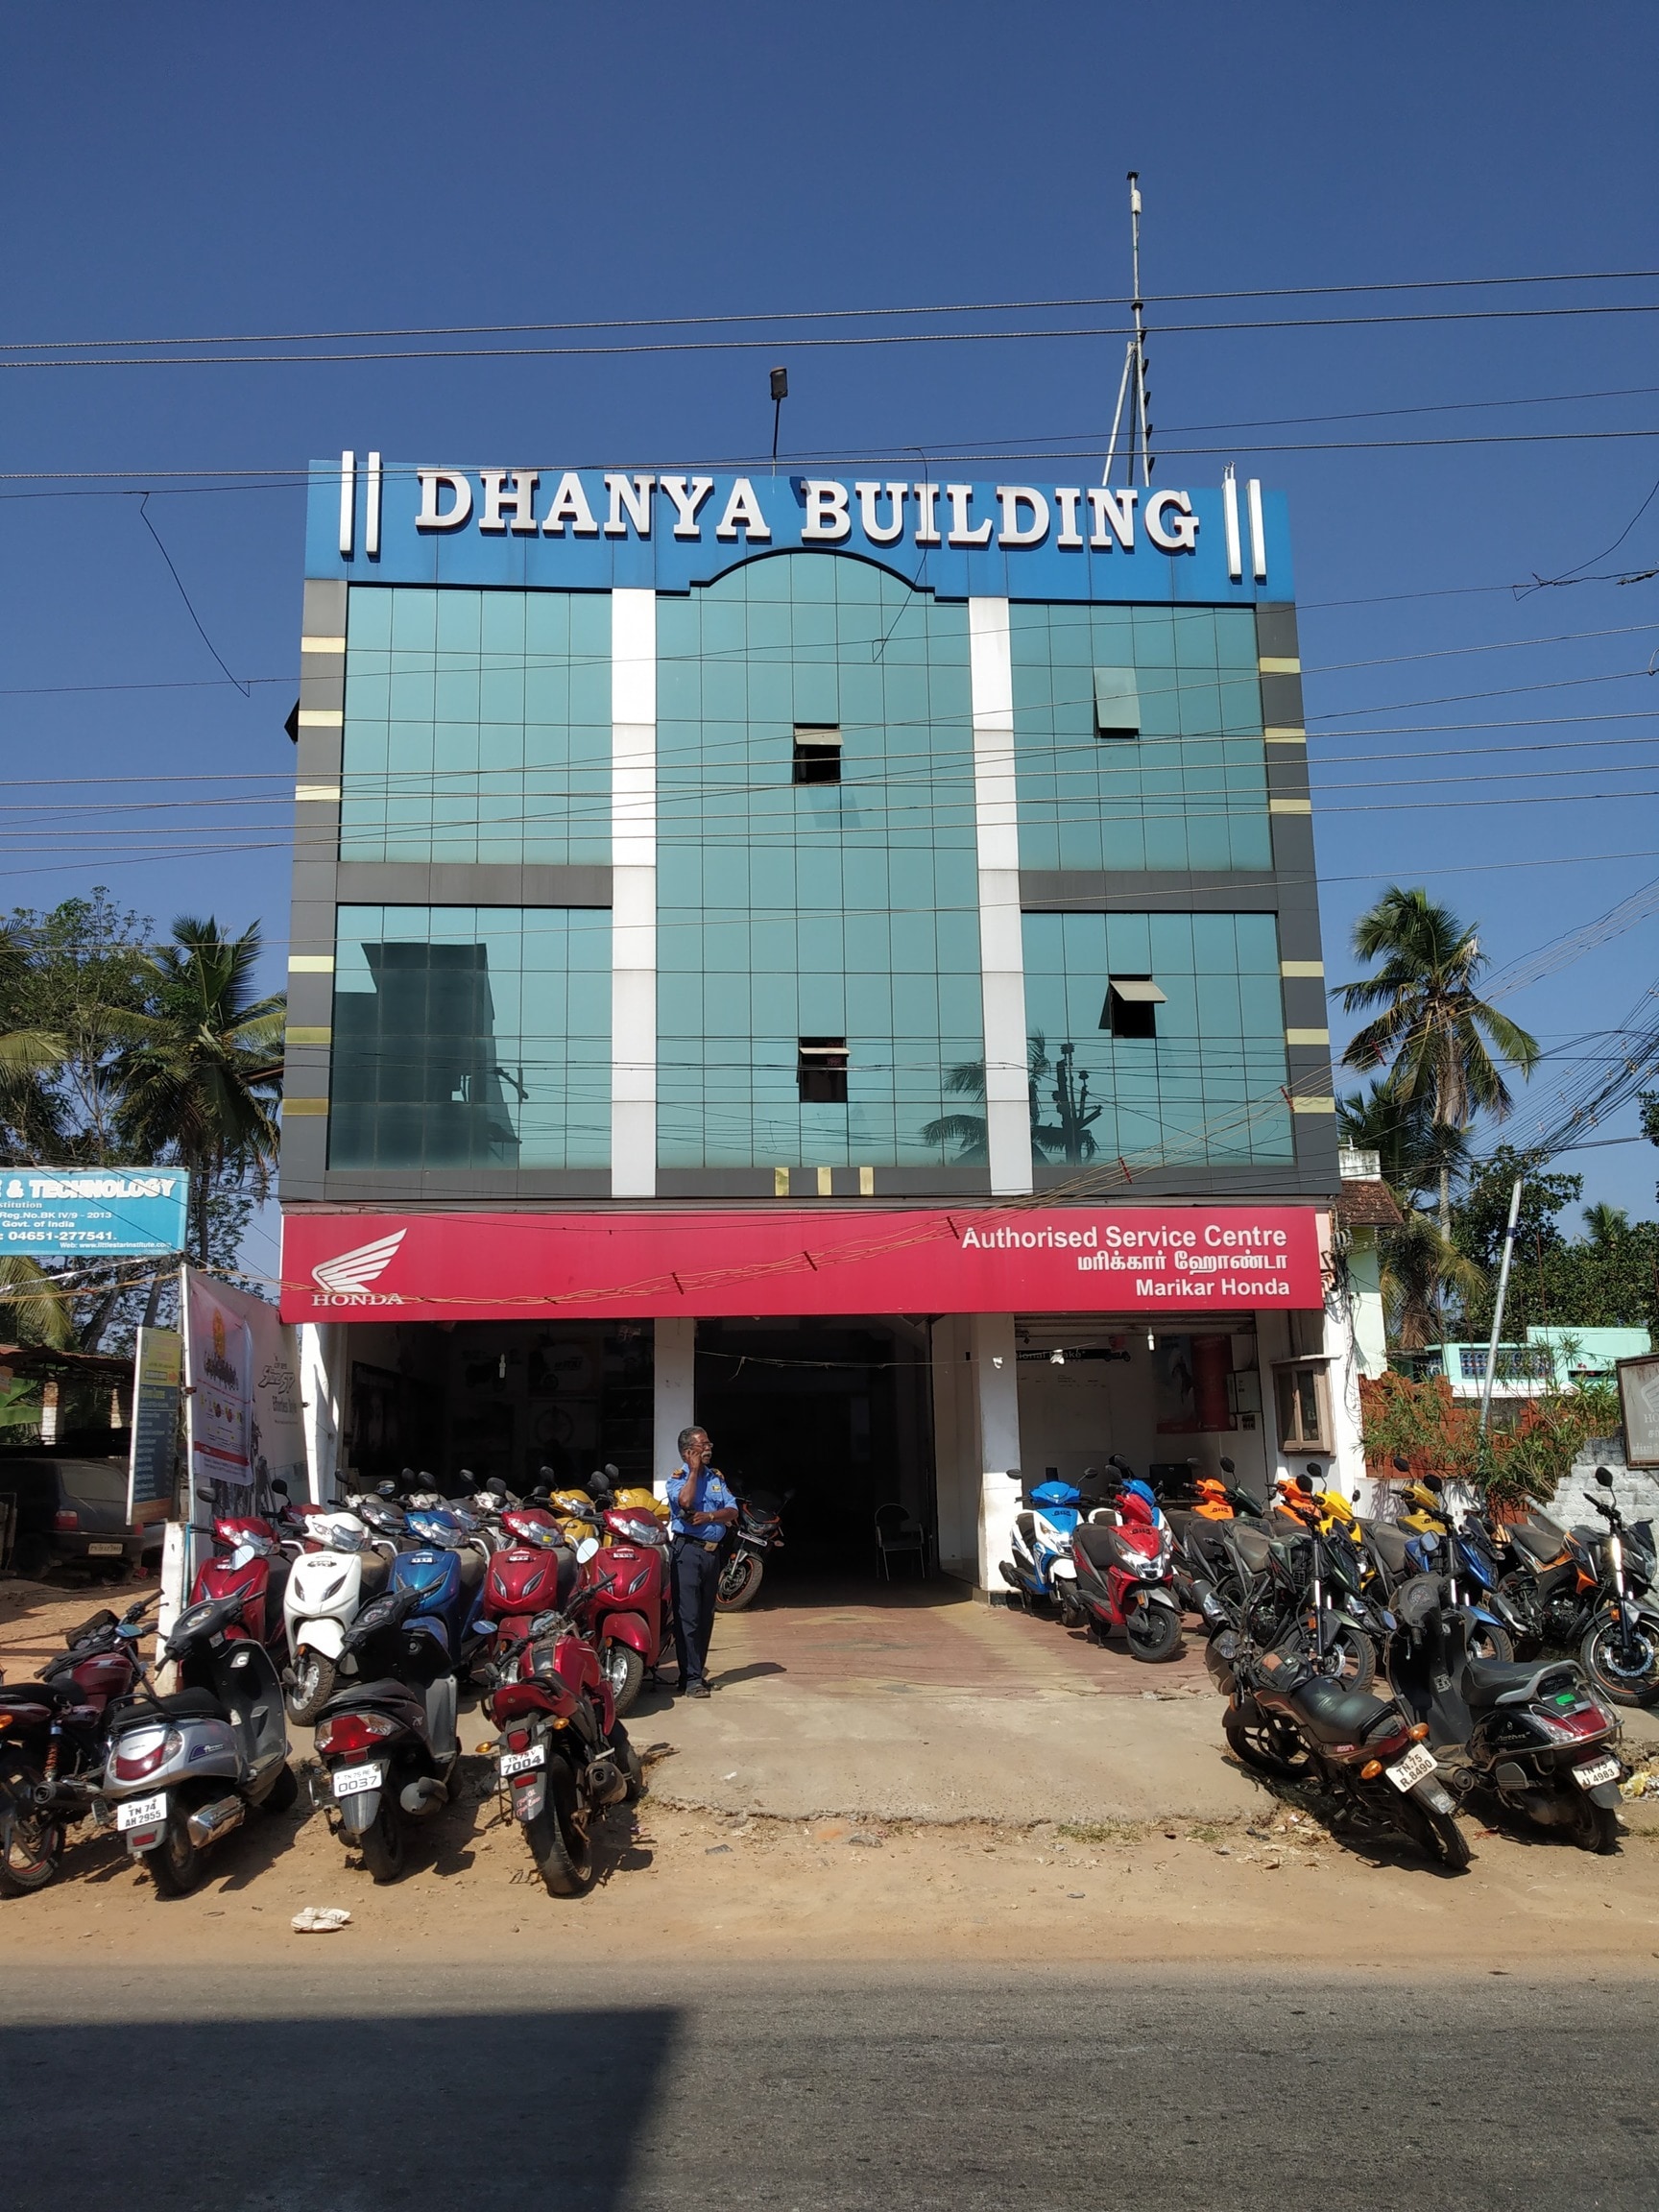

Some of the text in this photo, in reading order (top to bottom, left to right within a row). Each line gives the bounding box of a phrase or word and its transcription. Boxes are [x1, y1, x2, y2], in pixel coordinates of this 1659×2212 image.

[415, 468, 1200, 551] DHANYA BUILDING
[6, 1178, 177, 1199] & TECHNOLOGY
[961, 1224, 1287, 1249] Authorised Service Centre
[1077, 1249, 1288, 1275] மரிக்கார் ஹோண்டா
[1136, 1278, 1290, 1297] Marikar Honda
[311, 1293, 405, 1307] HONDA
[503, 1754, 542, 1774] 7004
[338, 1775, 377, 1792] 0037
[1593, 1767, 1615, 1782] 4983
[124, 1809, 161, 1827] AH 2955
[128, 1803, 156, 1817] TN 74
